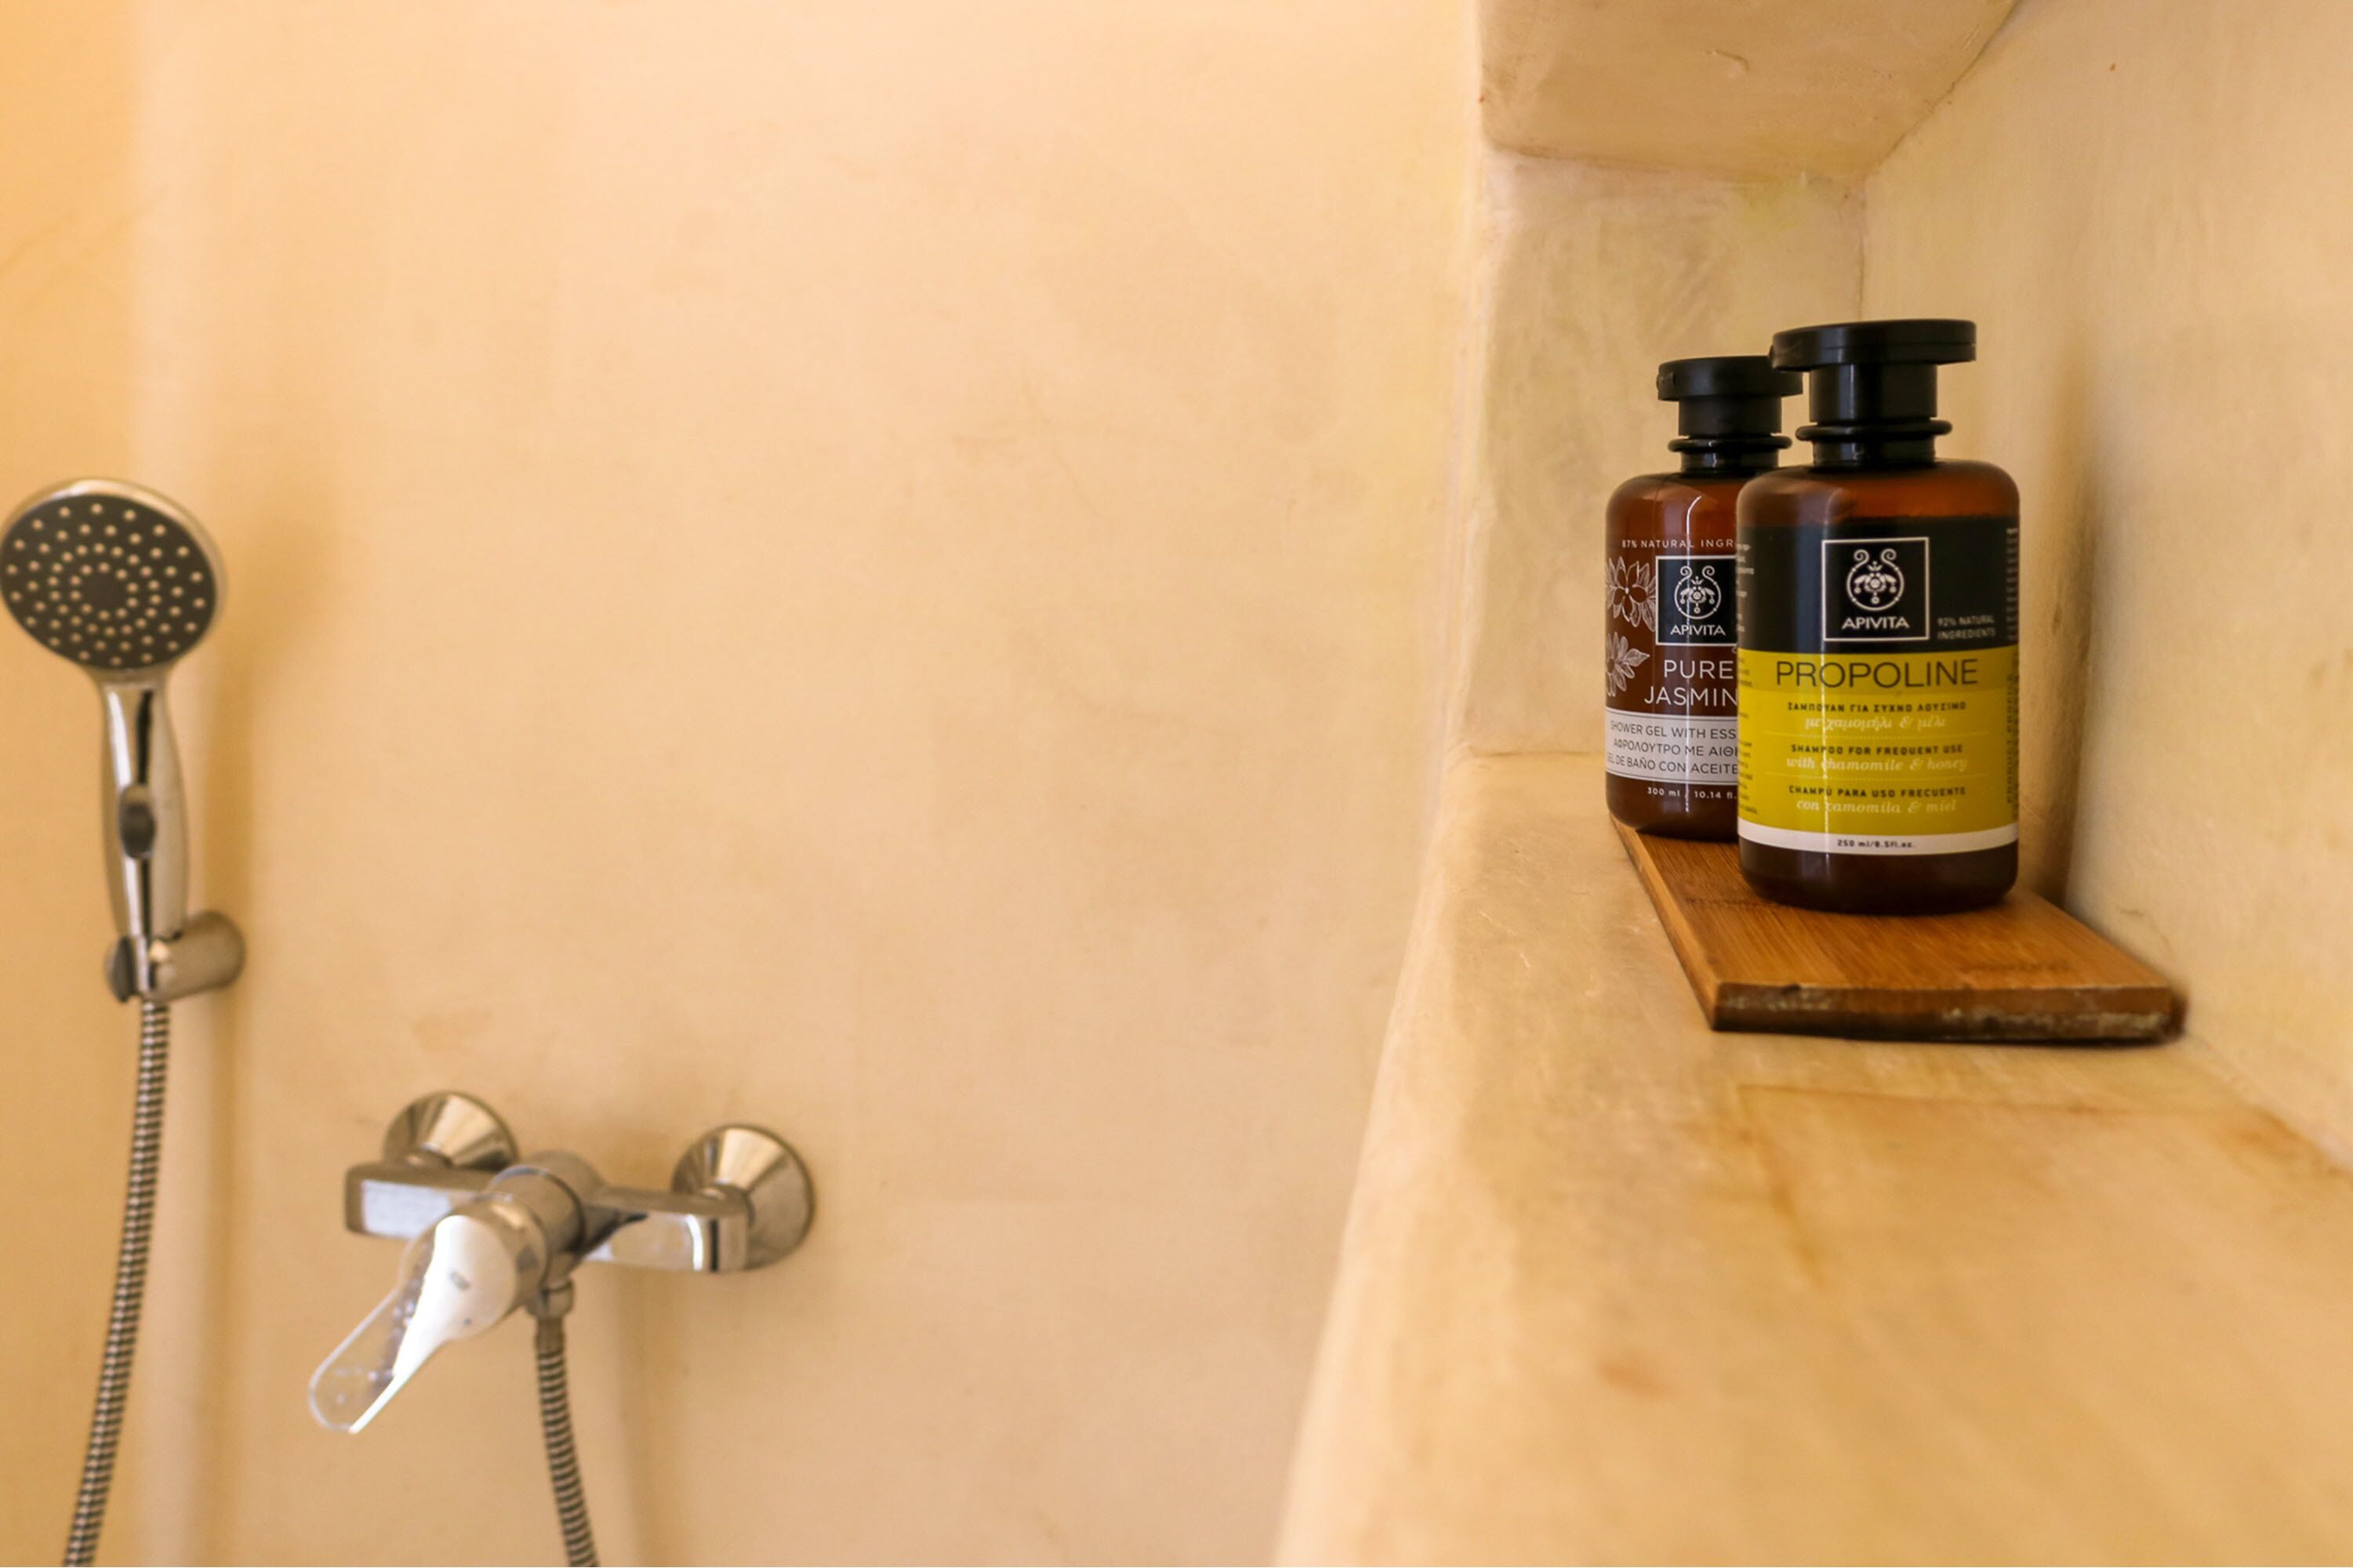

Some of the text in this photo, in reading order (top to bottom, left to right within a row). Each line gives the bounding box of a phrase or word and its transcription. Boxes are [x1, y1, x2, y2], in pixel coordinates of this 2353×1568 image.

[1621, 539, 1637, 548] 87%
[1640, 539, 1694, 548] NATURAL
[1843, 616, 1910, 630] APIVITA
[1959, 615, 1995, 625] NATURAL
[1670, 625, 1727, 636] APIVITA
[1937, 627, 1995, 640] INGREDIENTS
[1664, 659, 1734, 680] PURE
[1776, 659, 1978, 688] PROPOLINE
[1874, 704, 1912, 713] ΣΥΧΝΟ
[1610, 720, 1736, 739] SHOWER GEL WITH ESS
[1614, 738, 1681, 755] ΑΦΡΟΛΟΥΤΡΟ
[1686, 746, 1704, 757] ΜΕ
[1792, 744, 1843, 755] SHAMPOO
[1876, 746, 1939, 756] FREQUENT
[1944, 744, 1963, 753] USE
[1616, 754, 1625, 766] DE
[1627, 756, 1656, 771] BAÑO
[1658, 760, 1686, 772] CON
[1787, 757, 1816, 770] with
[1821, 757, 1904, 771] chamomile
[1927, 757, 1968, 771] honey
[1647, 786, 1665, 795] 300
[1694, 790, 1721, 799] 10.14
[1838, 787, 1866, 797] PARA
[1872, 788, 1895, 797] USO
[1901, 786, 1966, 797] FRECUENTE
[1796, 799, 1820, 811] con
[1926, 797, 1956, 812] miel
